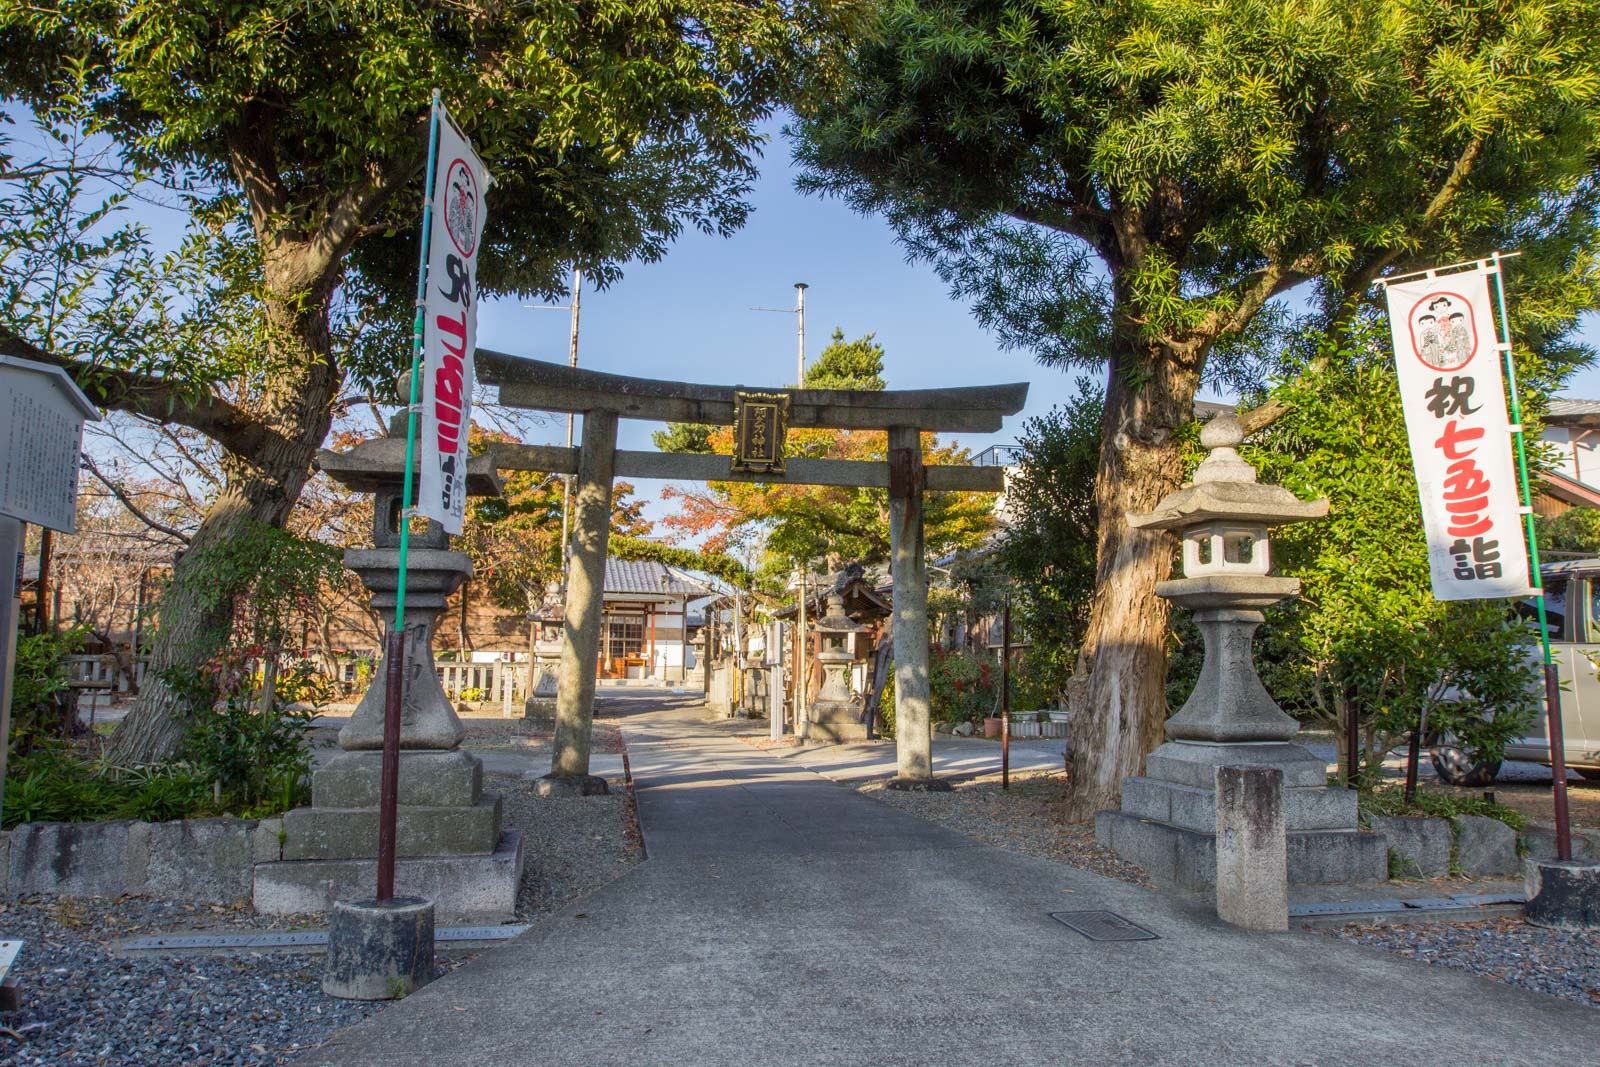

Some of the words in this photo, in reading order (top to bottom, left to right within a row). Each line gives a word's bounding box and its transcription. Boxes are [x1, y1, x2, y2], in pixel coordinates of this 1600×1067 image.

[1425, 376, 1502, 581] 祝七五三詣
